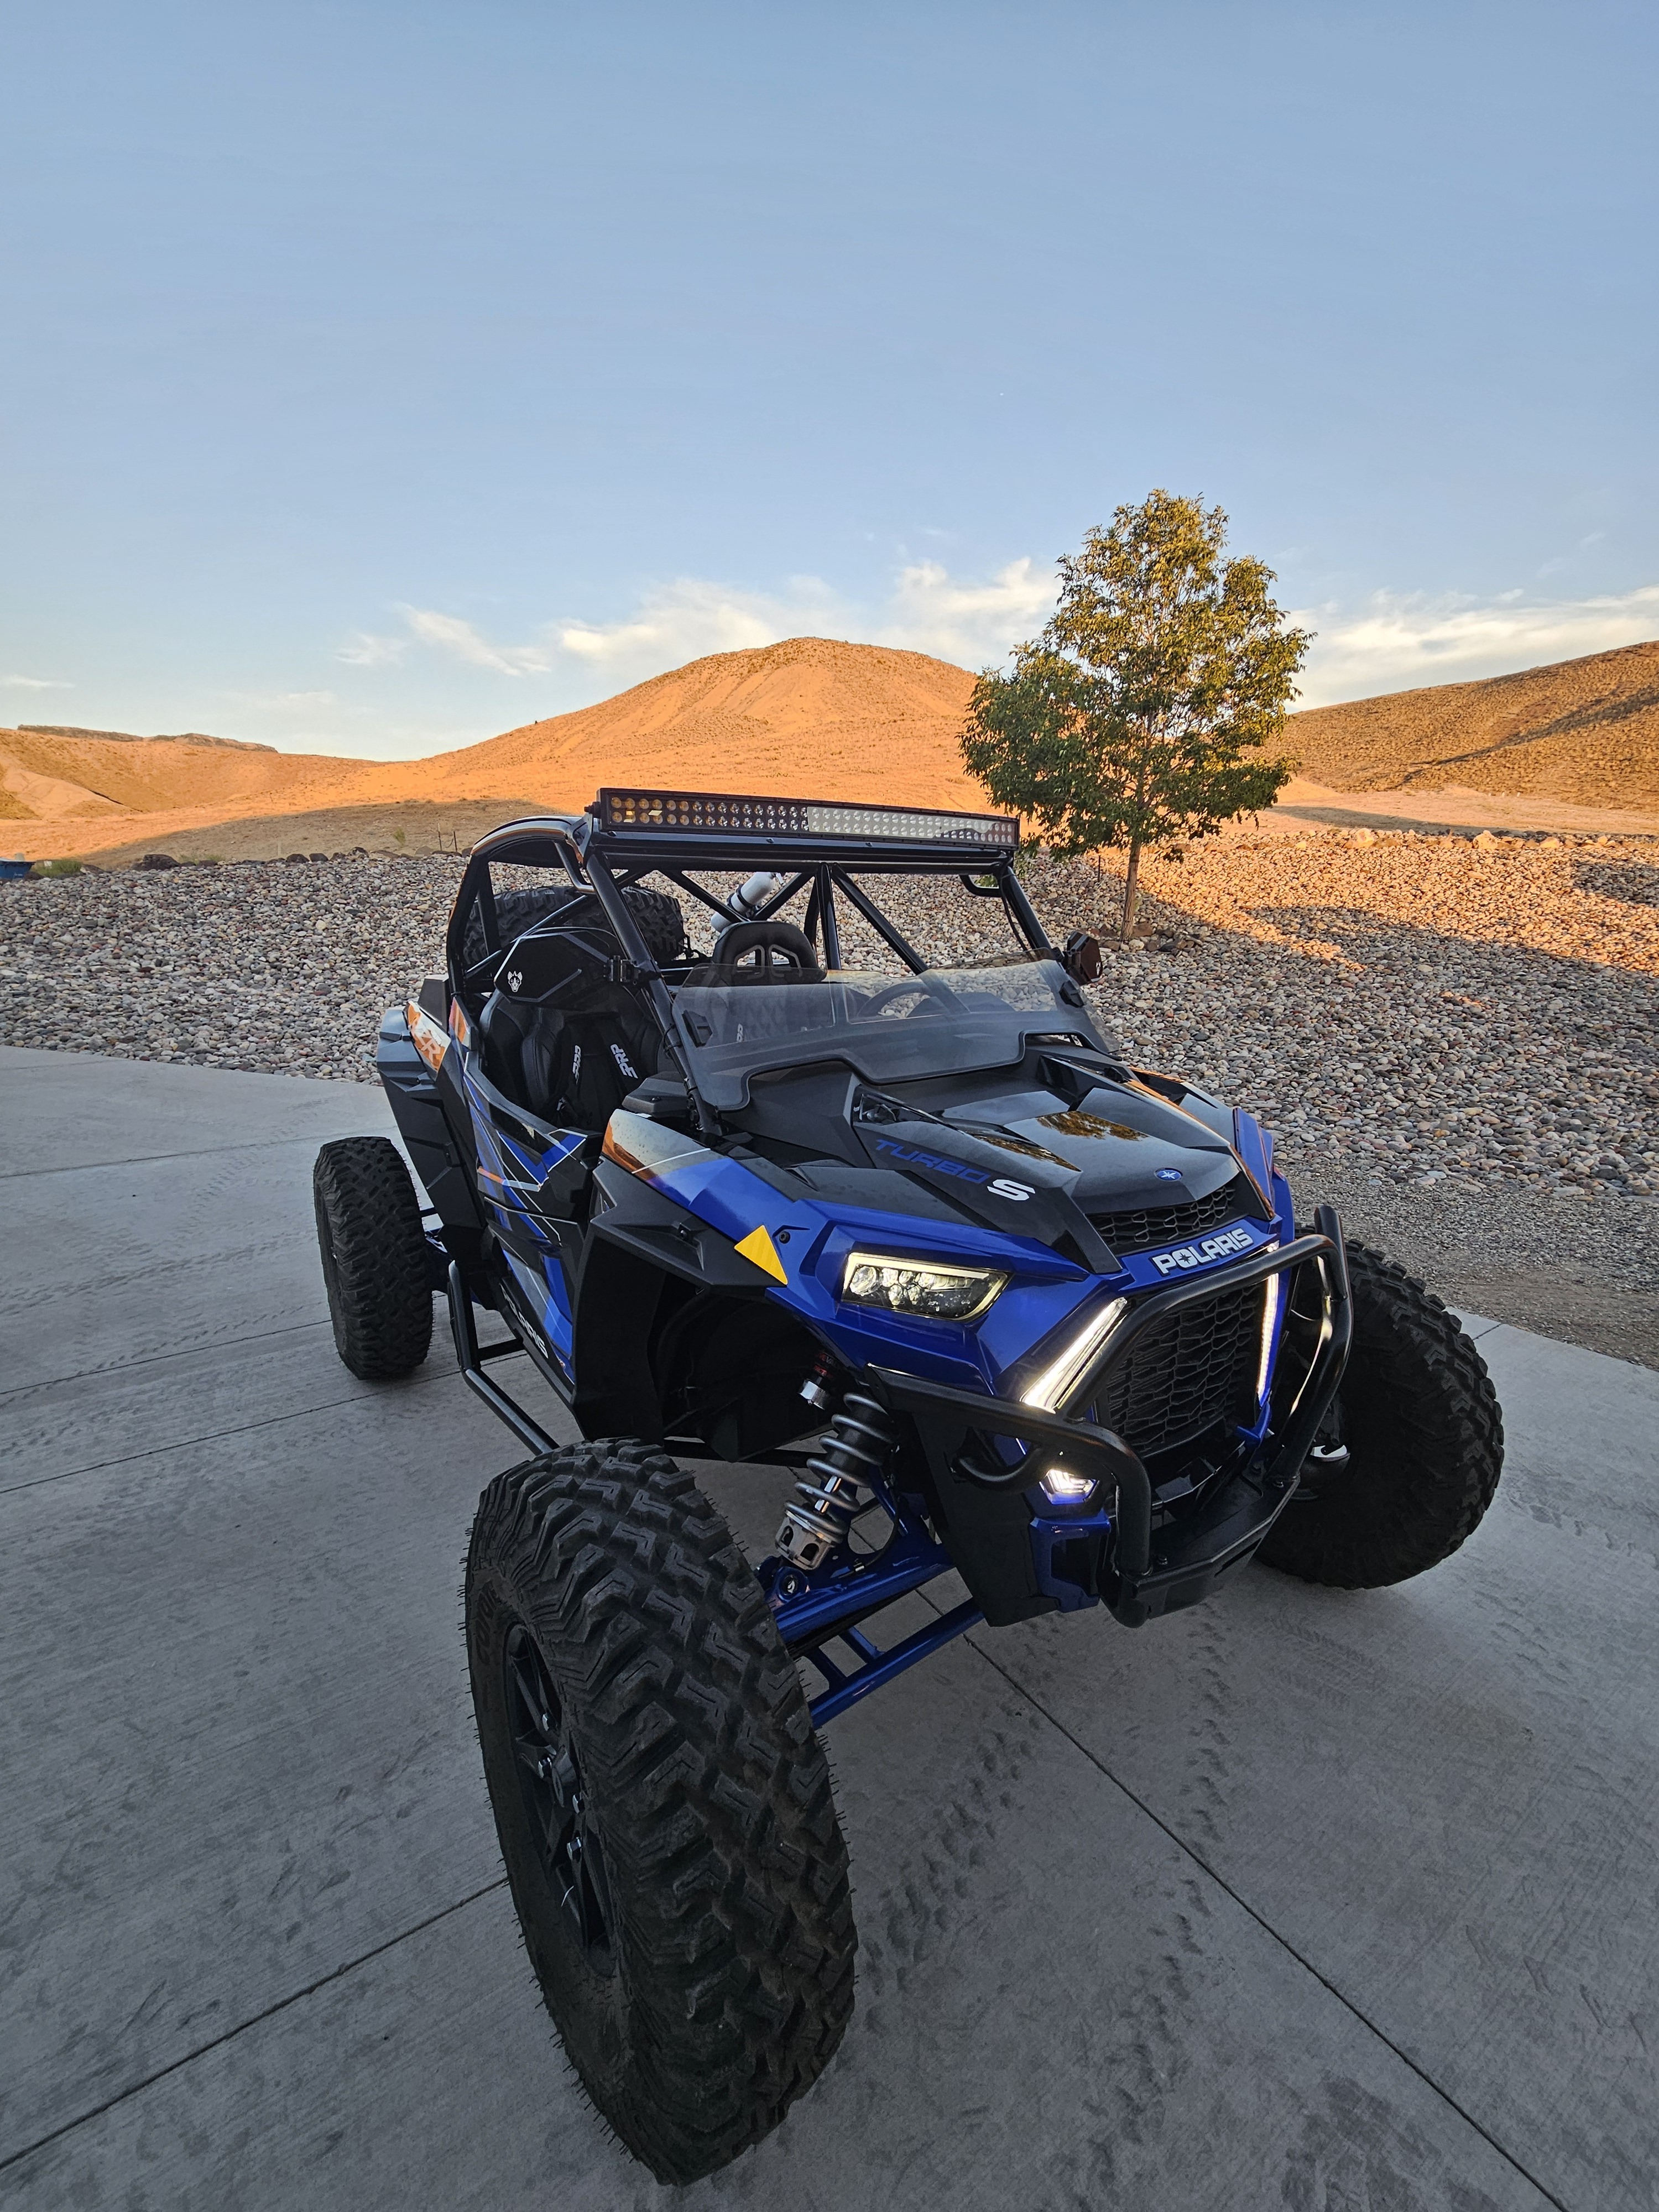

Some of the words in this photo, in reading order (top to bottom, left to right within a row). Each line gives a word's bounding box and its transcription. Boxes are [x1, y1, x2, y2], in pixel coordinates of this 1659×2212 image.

[610, 1044, 639, 1079] PRP
[876, 1139, 992, 1184] TURBO
[987, 1179, 1036, 1201] S
[1151, 1227, 1255, 1275] POLARIS
